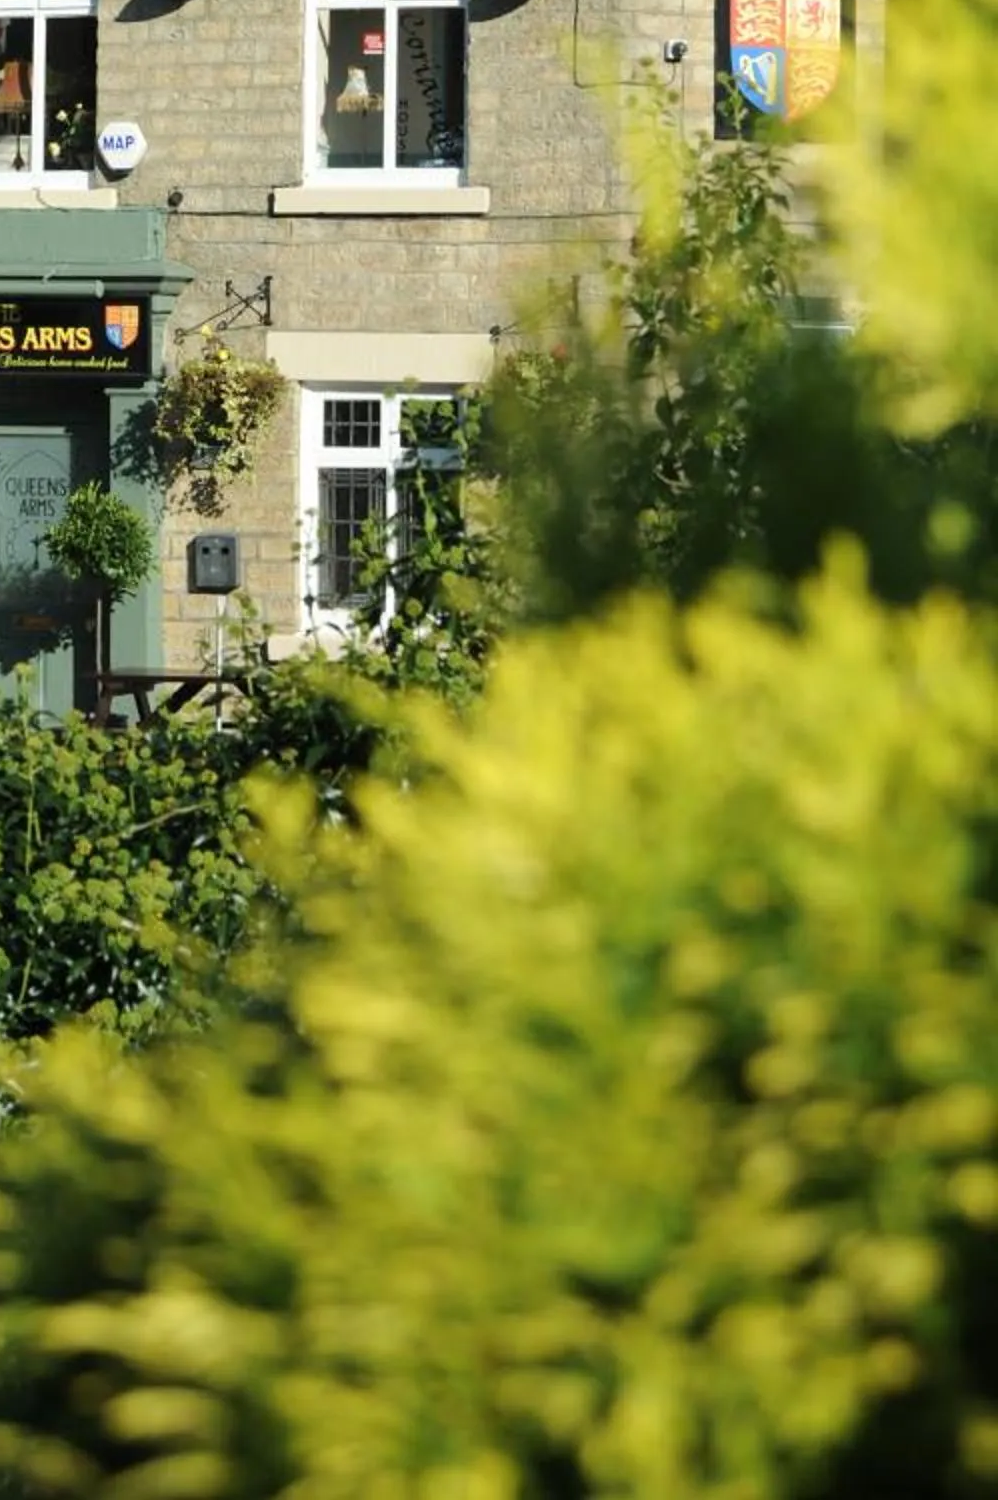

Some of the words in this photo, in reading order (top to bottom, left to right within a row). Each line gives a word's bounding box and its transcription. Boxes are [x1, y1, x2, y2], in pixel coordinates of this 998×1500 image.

[103, 136, 135, 150] MAP
[21, 327, 92, 350] ARMS
[5, 477, 67, 497] QUEENS
[18, 499, 56, 516] ARMS
